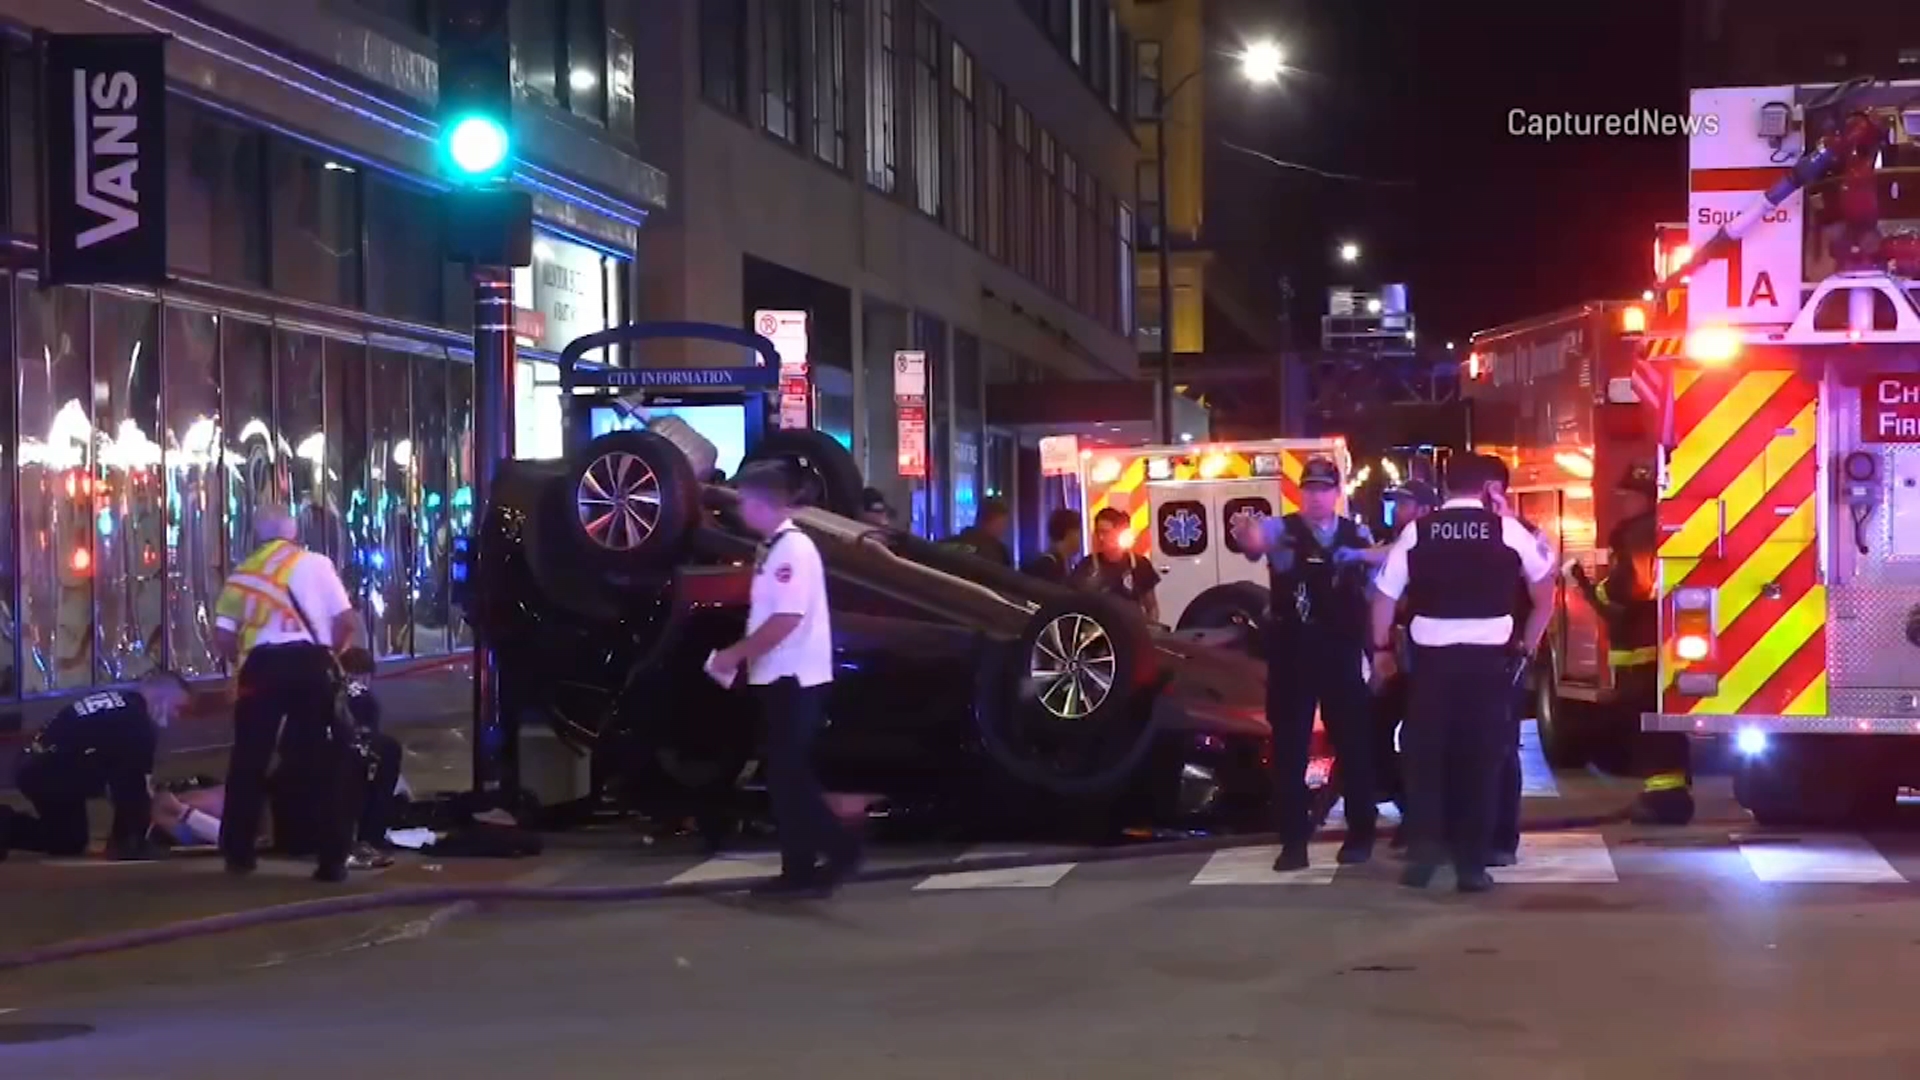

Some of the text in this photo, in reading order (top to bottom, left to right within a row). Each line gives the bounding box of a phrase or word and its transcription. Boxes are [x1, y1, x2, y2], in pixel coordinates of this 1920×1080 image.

[74, 68, 139, 249] VANS
[607, 369, 733, 386] CITY INFORMATION
[1879, 412, 1920, 435] FIR
[1431, 522, 1490, 539] POLICE
